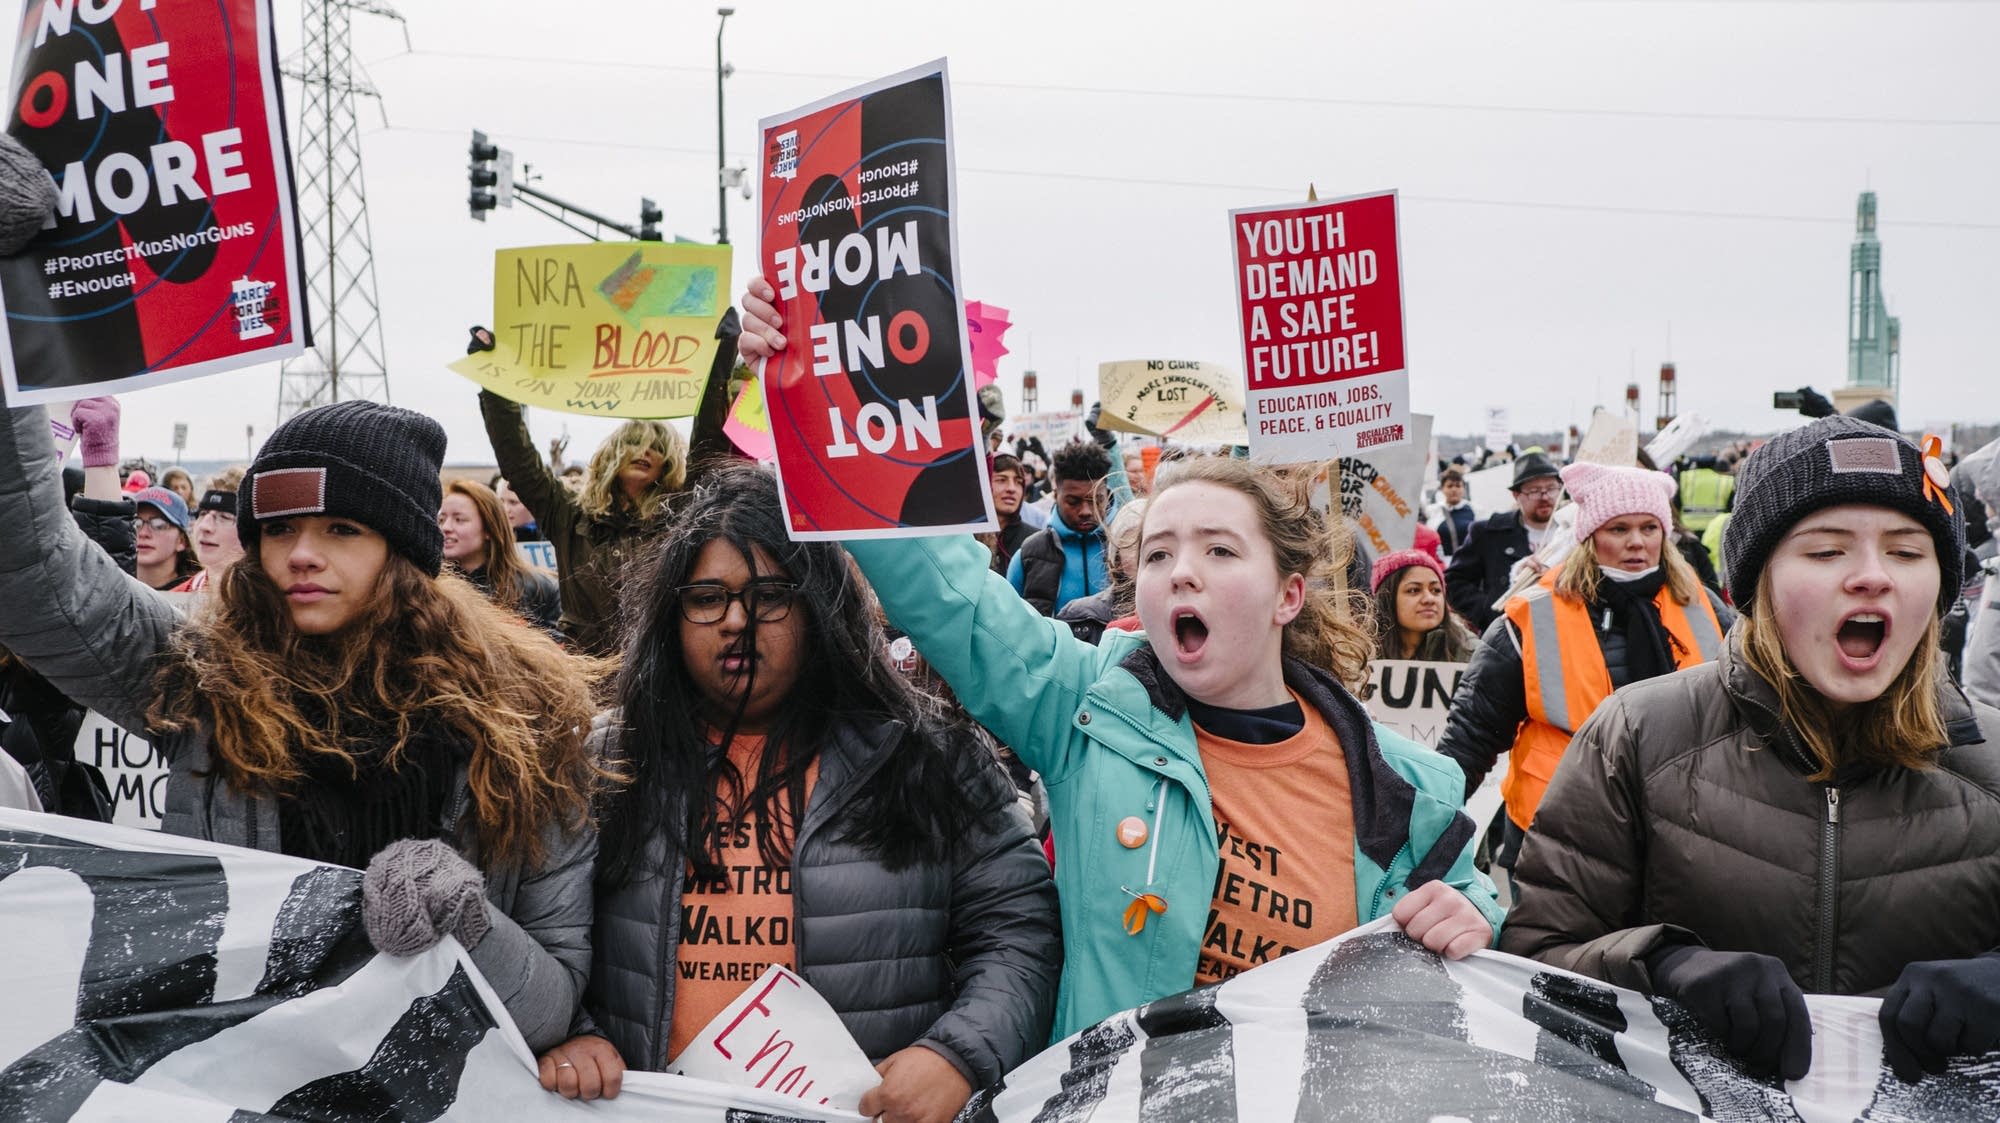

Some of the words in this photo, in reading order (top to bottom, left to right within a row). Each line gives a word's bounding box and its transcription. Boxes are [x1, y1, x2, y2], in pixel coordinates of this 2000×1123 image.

[19, 41, 175, 129] ONE
[43, 127, 251, 230] MORE
[773, 159, 800, 175] MARCH
[1242, 211, 1345, 258] YOUTH
[774, 220, 922, 301] MORE
[1246, 249, 1378, 300] DEMAND
[229, 284, 271, 304] MARCH
[517, 258, 585, 308] NRA
[231, 303, 253, 319] FOR
[1251, 306, 1271, 341] A
[1280, 294, 1357, 338] SAFE
[510, 324, 571, 369] THE
[593, 323, 700, 369] BLOOD
[810, 310, 931, 376] ONE
[1253, 331, 1379, 382] FUTURE!
[477, 362, 507, 378] IS
[515, 379, 555, 396] ON
[575, 380, 622, 399] YOUR
[632, 378, 703, 401] HANDS
[1147, 361, 1164, 371] NO
[1168, 360, 1200, 371] GUNS
[1127, 405, 1138, 421] NO
[1137, 379, 1161, 401] MORE
[1163, 375, 1210, 391] INNOCENT
[1208, 388, 1228, 412] LIVES
[1157, 387, 1188, 402] LOST
[1258, 391, 1342, 414] EDUCATION,
[1346, 384, 1383, 404] JOBS,
[826, 395, 943, 459] NOT
[1260, 417, 1310, 435] PEACE,
[1315, 415, 1324, 430] &
[1329, 402, 1392, 428] EQUALITY
[1356, 425, 1395, 441] SOCIALIST
[1357, 433, 1404, 448] ALTERNATIVE
[1340, 478, 1364, 496] OR
[1341, 496, 1362, 511] UR
[714, 821, 773, 849] EST
[679, 905, 797, 945] WALKO
[678, 961, 793, 981] WEAREC
